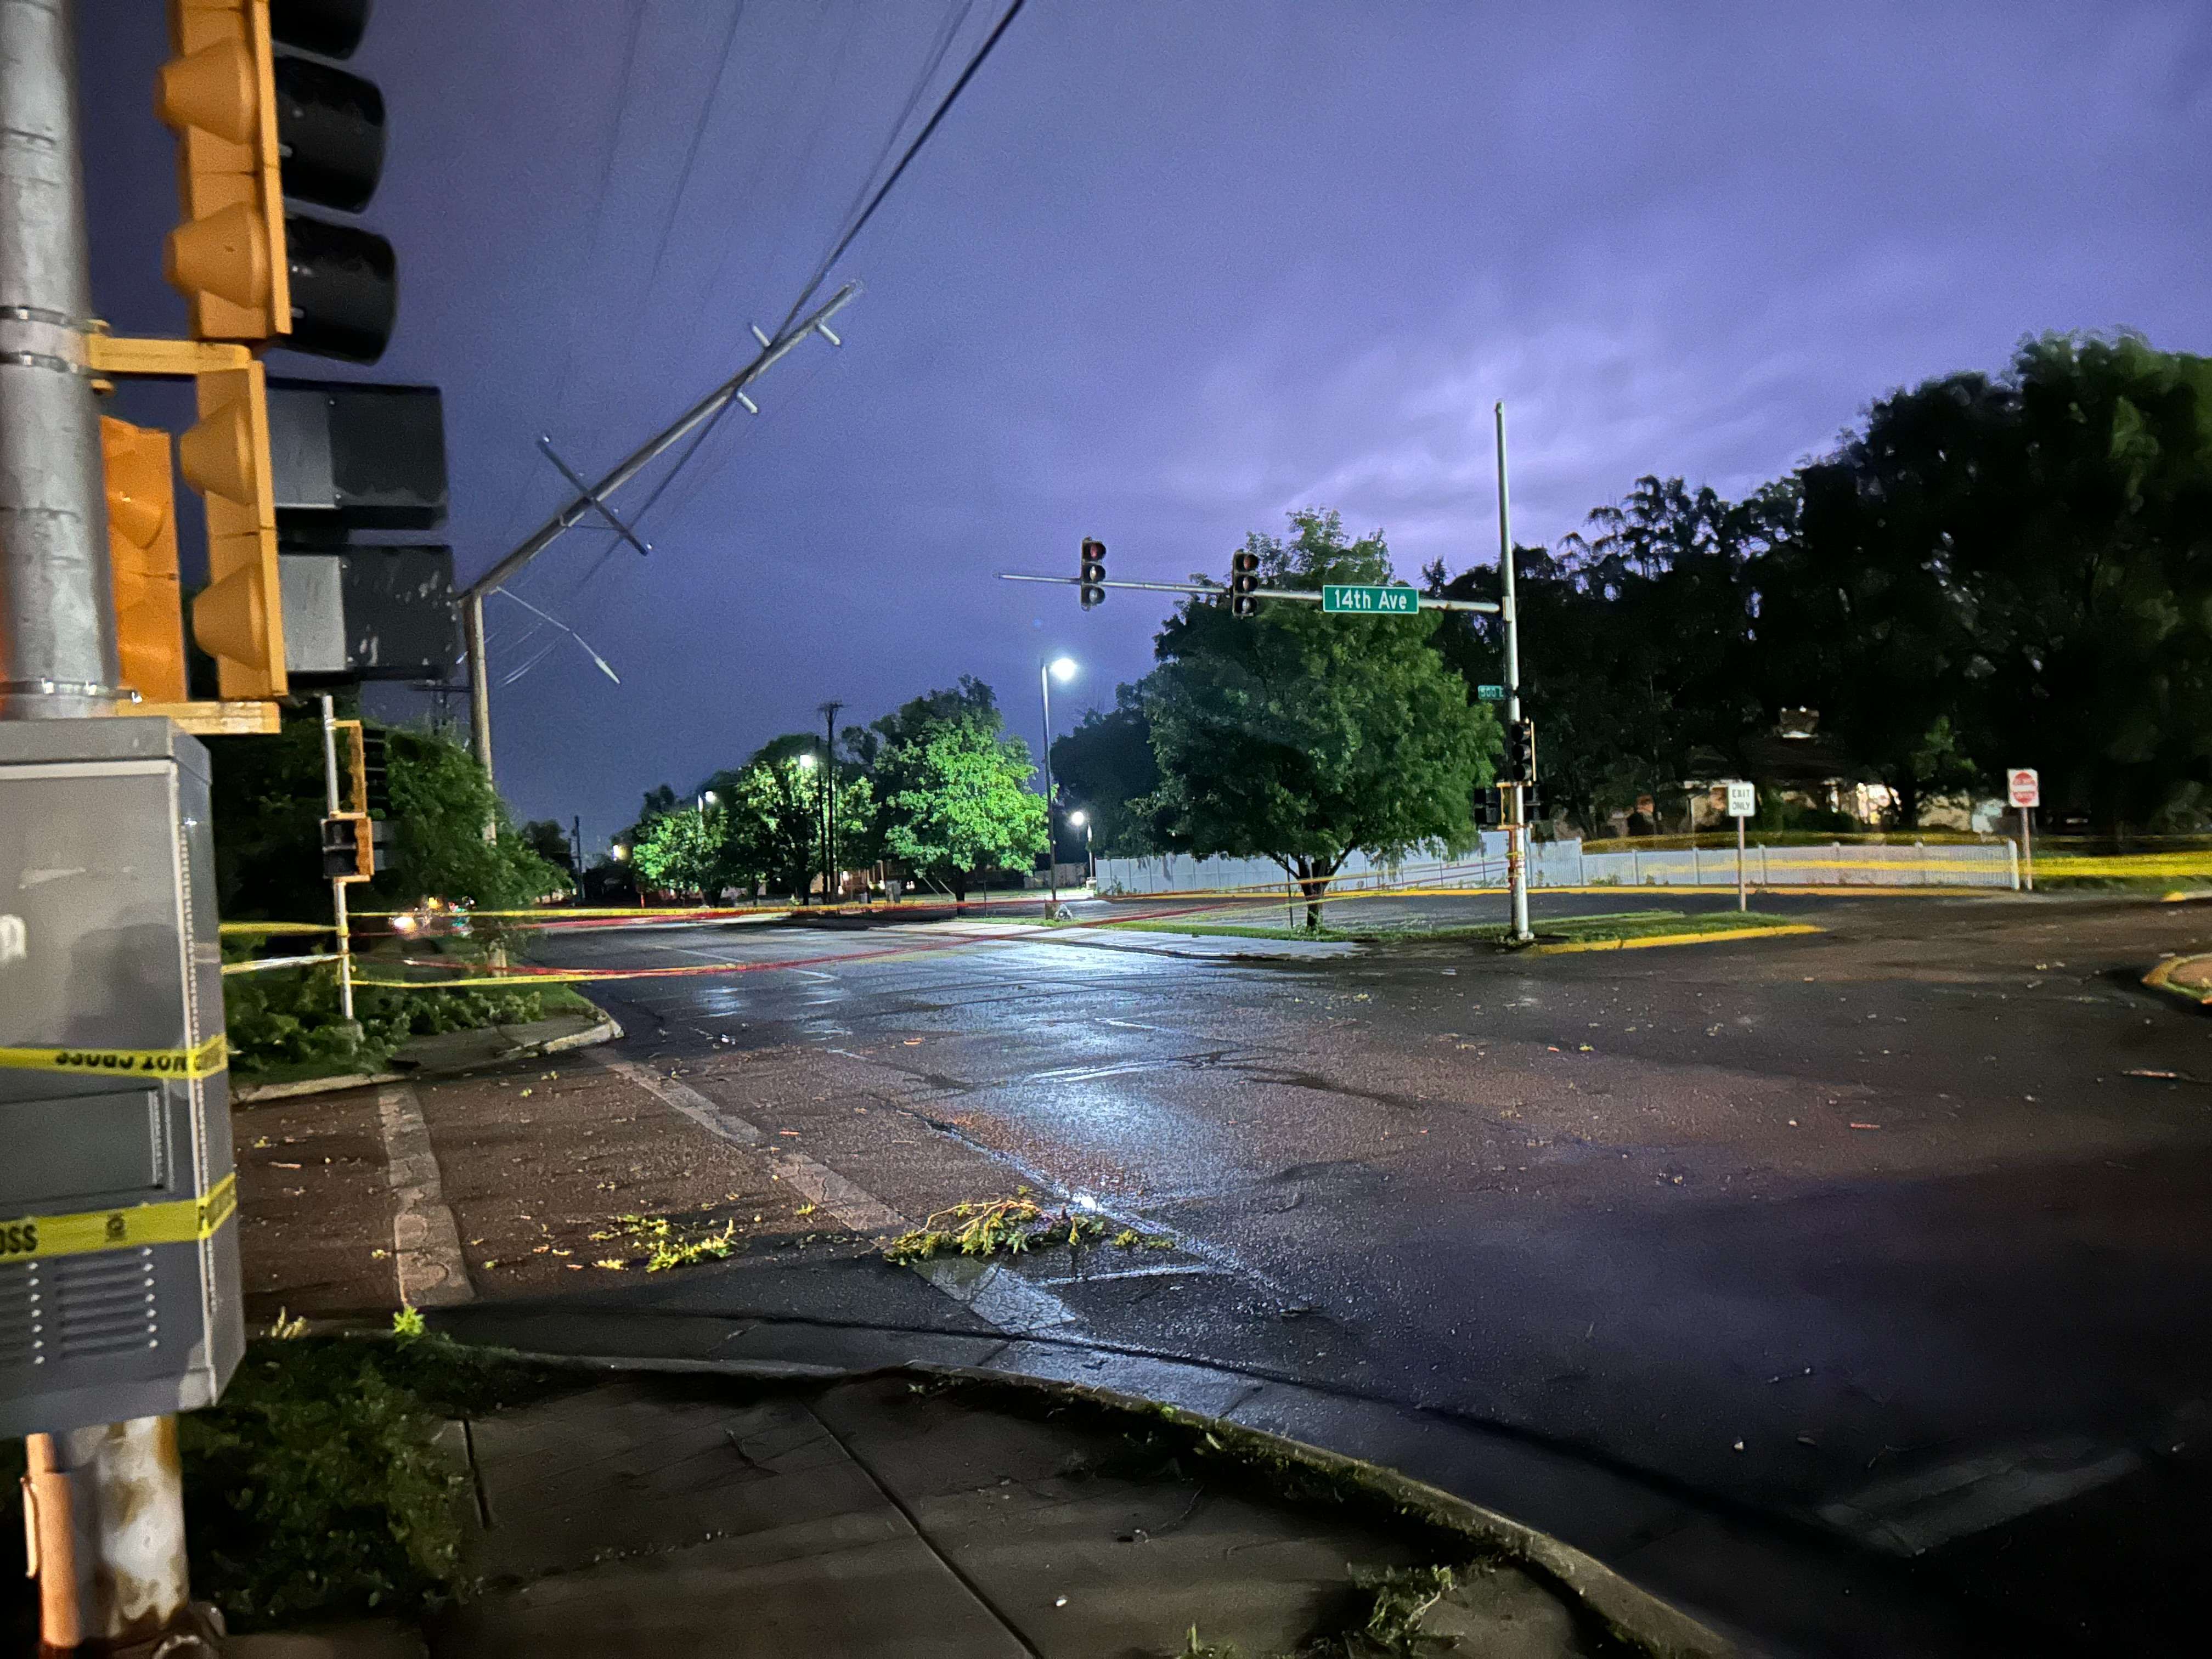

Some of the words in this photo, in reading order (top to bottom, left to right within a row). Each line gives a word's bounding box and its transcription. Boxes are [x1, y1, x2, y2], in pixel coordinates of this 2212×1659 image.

[1335, 589, 1371, 609] 14th
[1378, 590, 1407, 610] Ave
[1732, 789, 1750, 798] EXIT
[1732, 802, 1750, 810] ONLY
